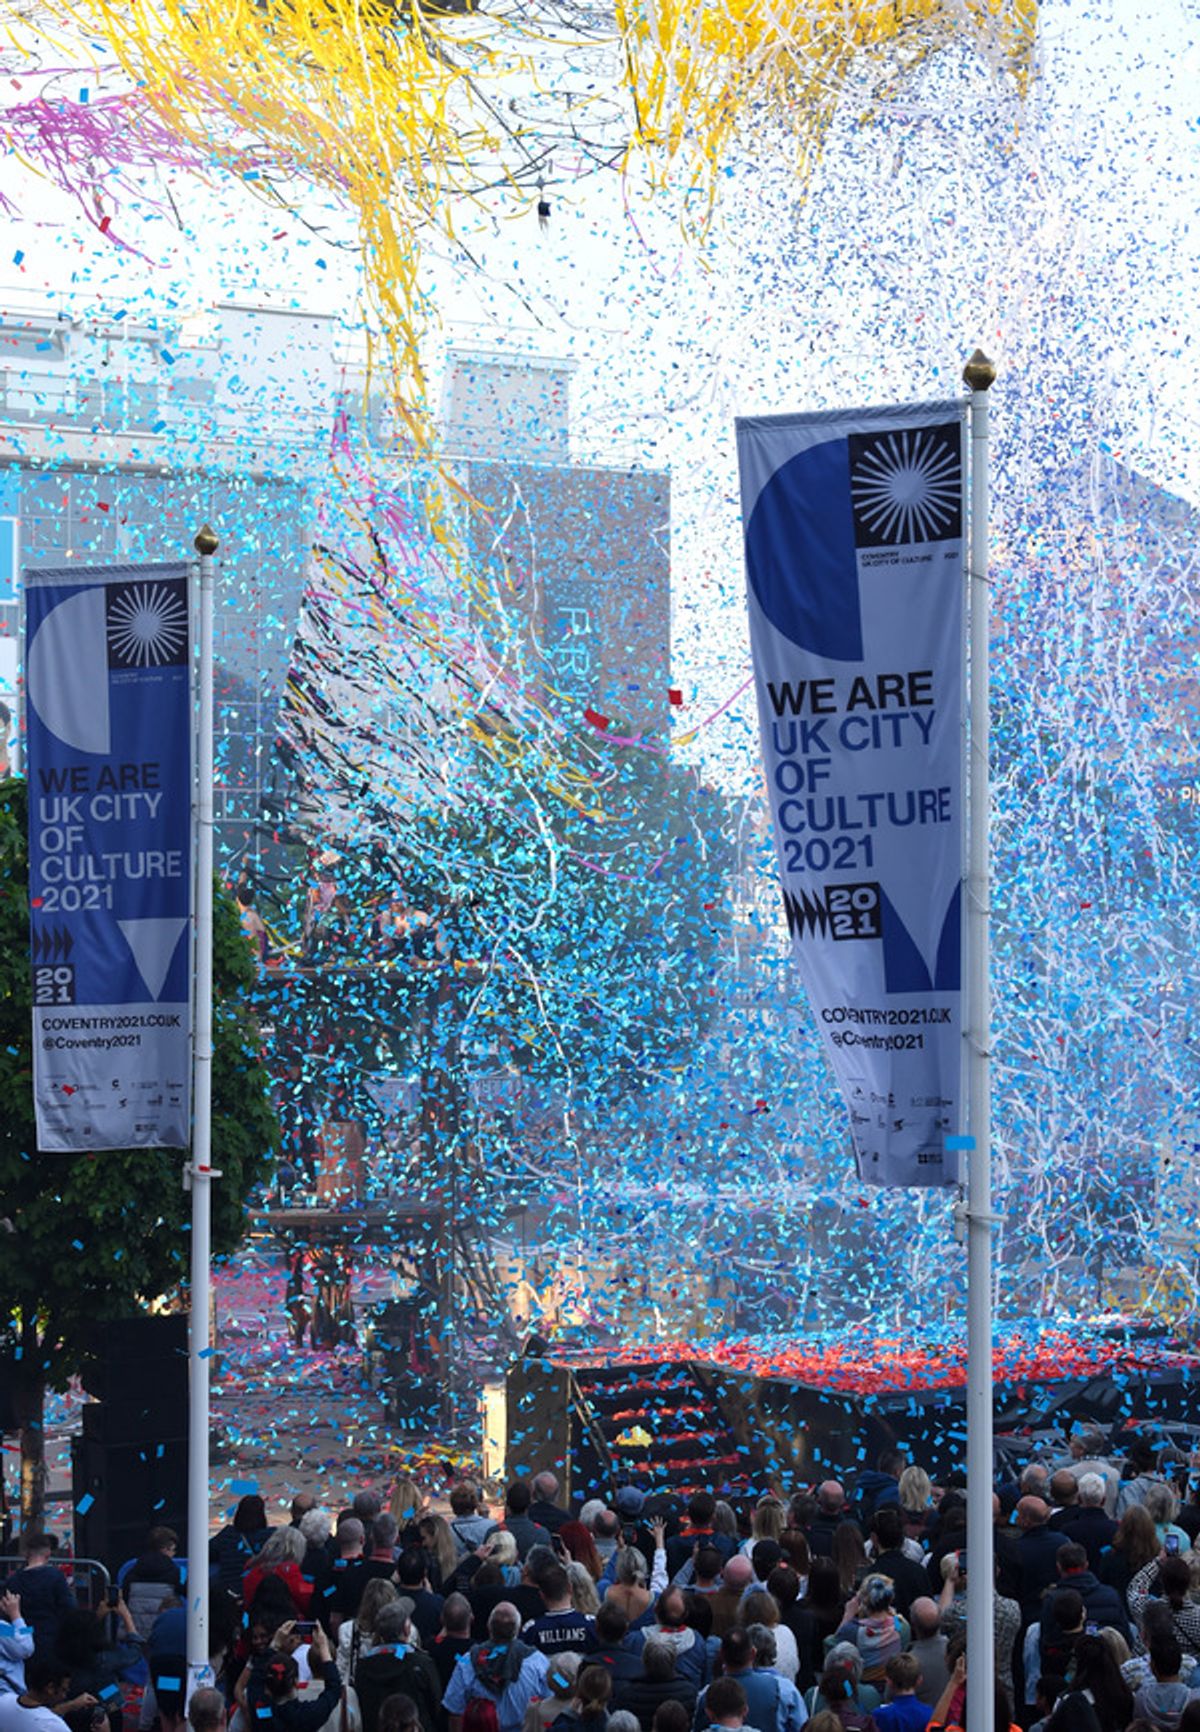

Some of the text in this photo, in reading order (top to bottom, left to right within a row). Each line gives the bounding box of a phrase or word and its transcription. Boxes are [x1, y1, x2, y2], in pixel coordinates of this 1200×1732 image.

[767, 670, 934, 717] WE ARE
[772, 710, 936, 756] UK CITY
[38, 763, 161, 794] WE ARE
[774, 758, 832, 795] OF
[39, 792, 163, 823] UK CITY
[778, 787, 952, 834] CULTURE
[40, 826, 85, 853] OF
[783, 834, 875, 873] 2021
[40, 851, 182, 882] CULTURE
[41, 884, 113, 912] 2021
[828, 886, 878, 912] 20
[832, 913, 877, 937] 21
[36, 966, 73, 985] 20
[36, 986, 72, 1004] 21
[42, 1034, 141, 1051] @Coventry2021
[538, 1627, 586, 1643] WILLIAMS
